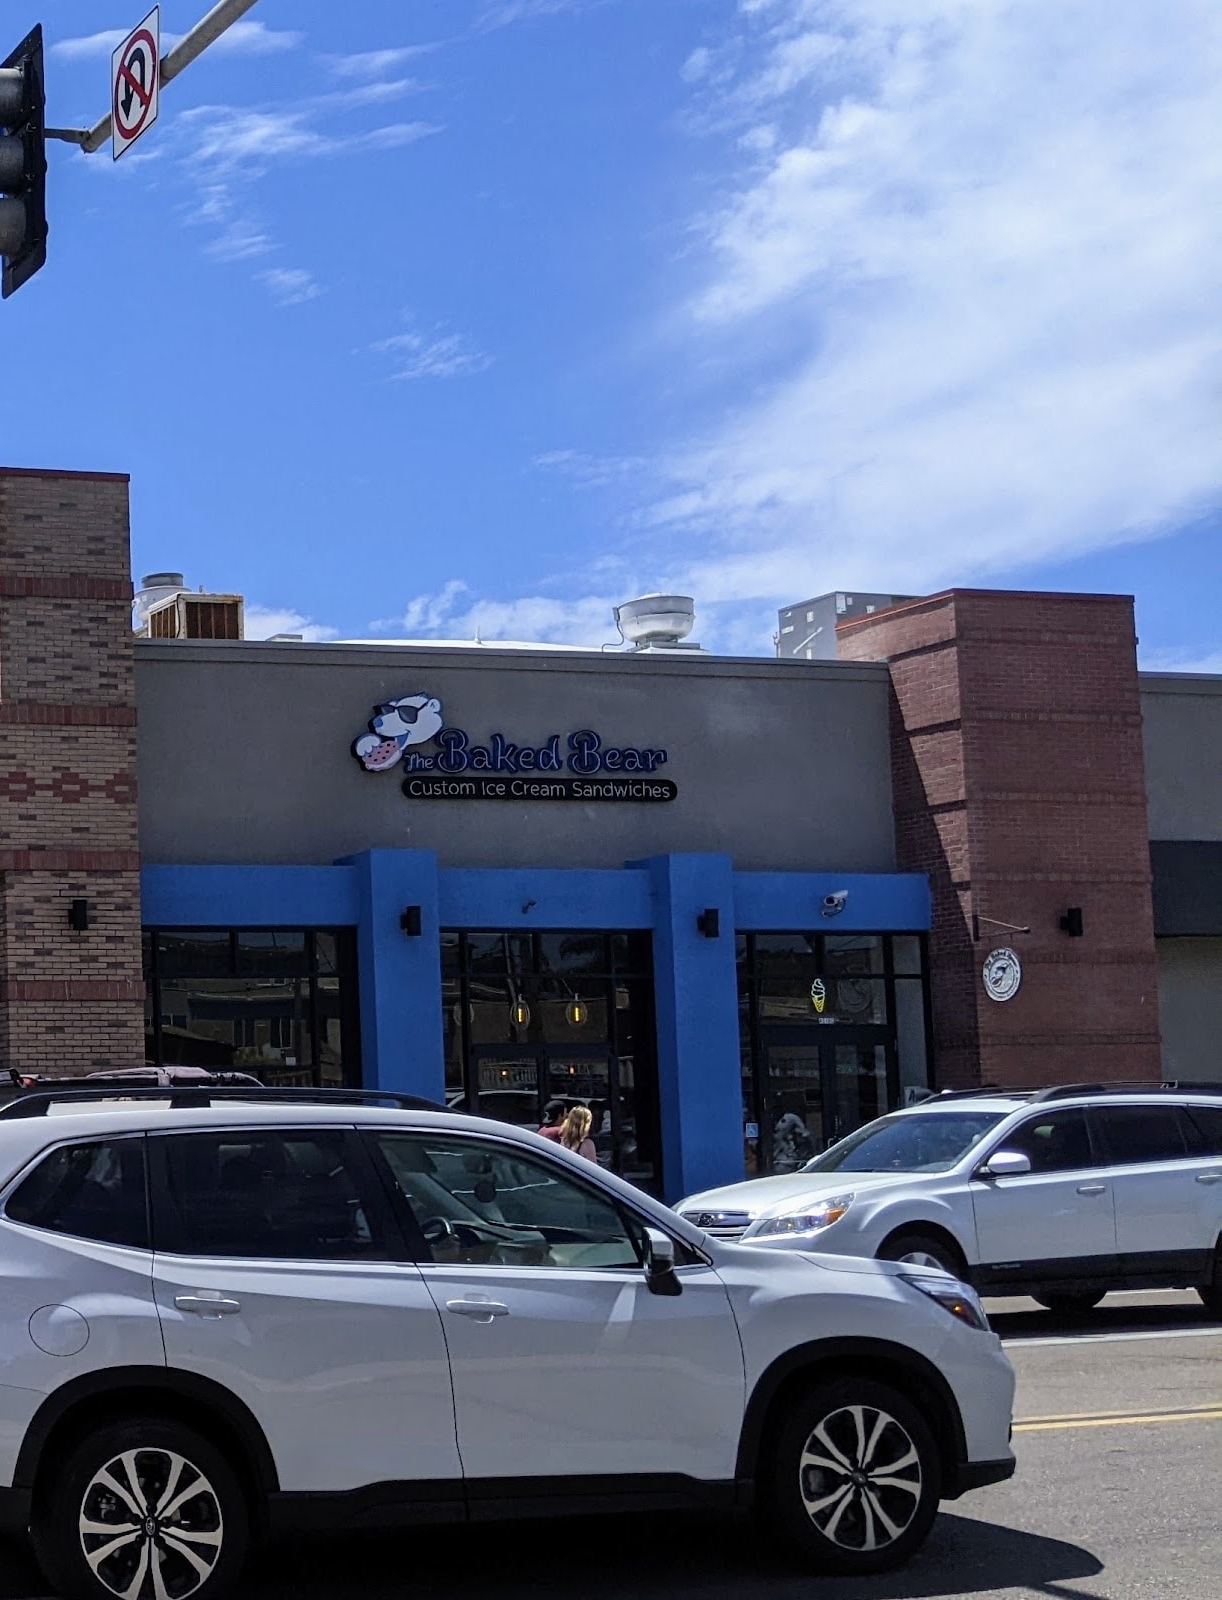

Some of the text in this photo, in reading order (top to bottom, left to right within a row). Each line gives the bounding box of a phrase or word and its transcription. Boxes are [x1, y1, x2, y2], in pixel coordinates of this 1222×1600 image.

[405, 728, 668, 776] The Baked Bear
[409, 780, 671, 799] Custom Ice Cream Sandwiches
